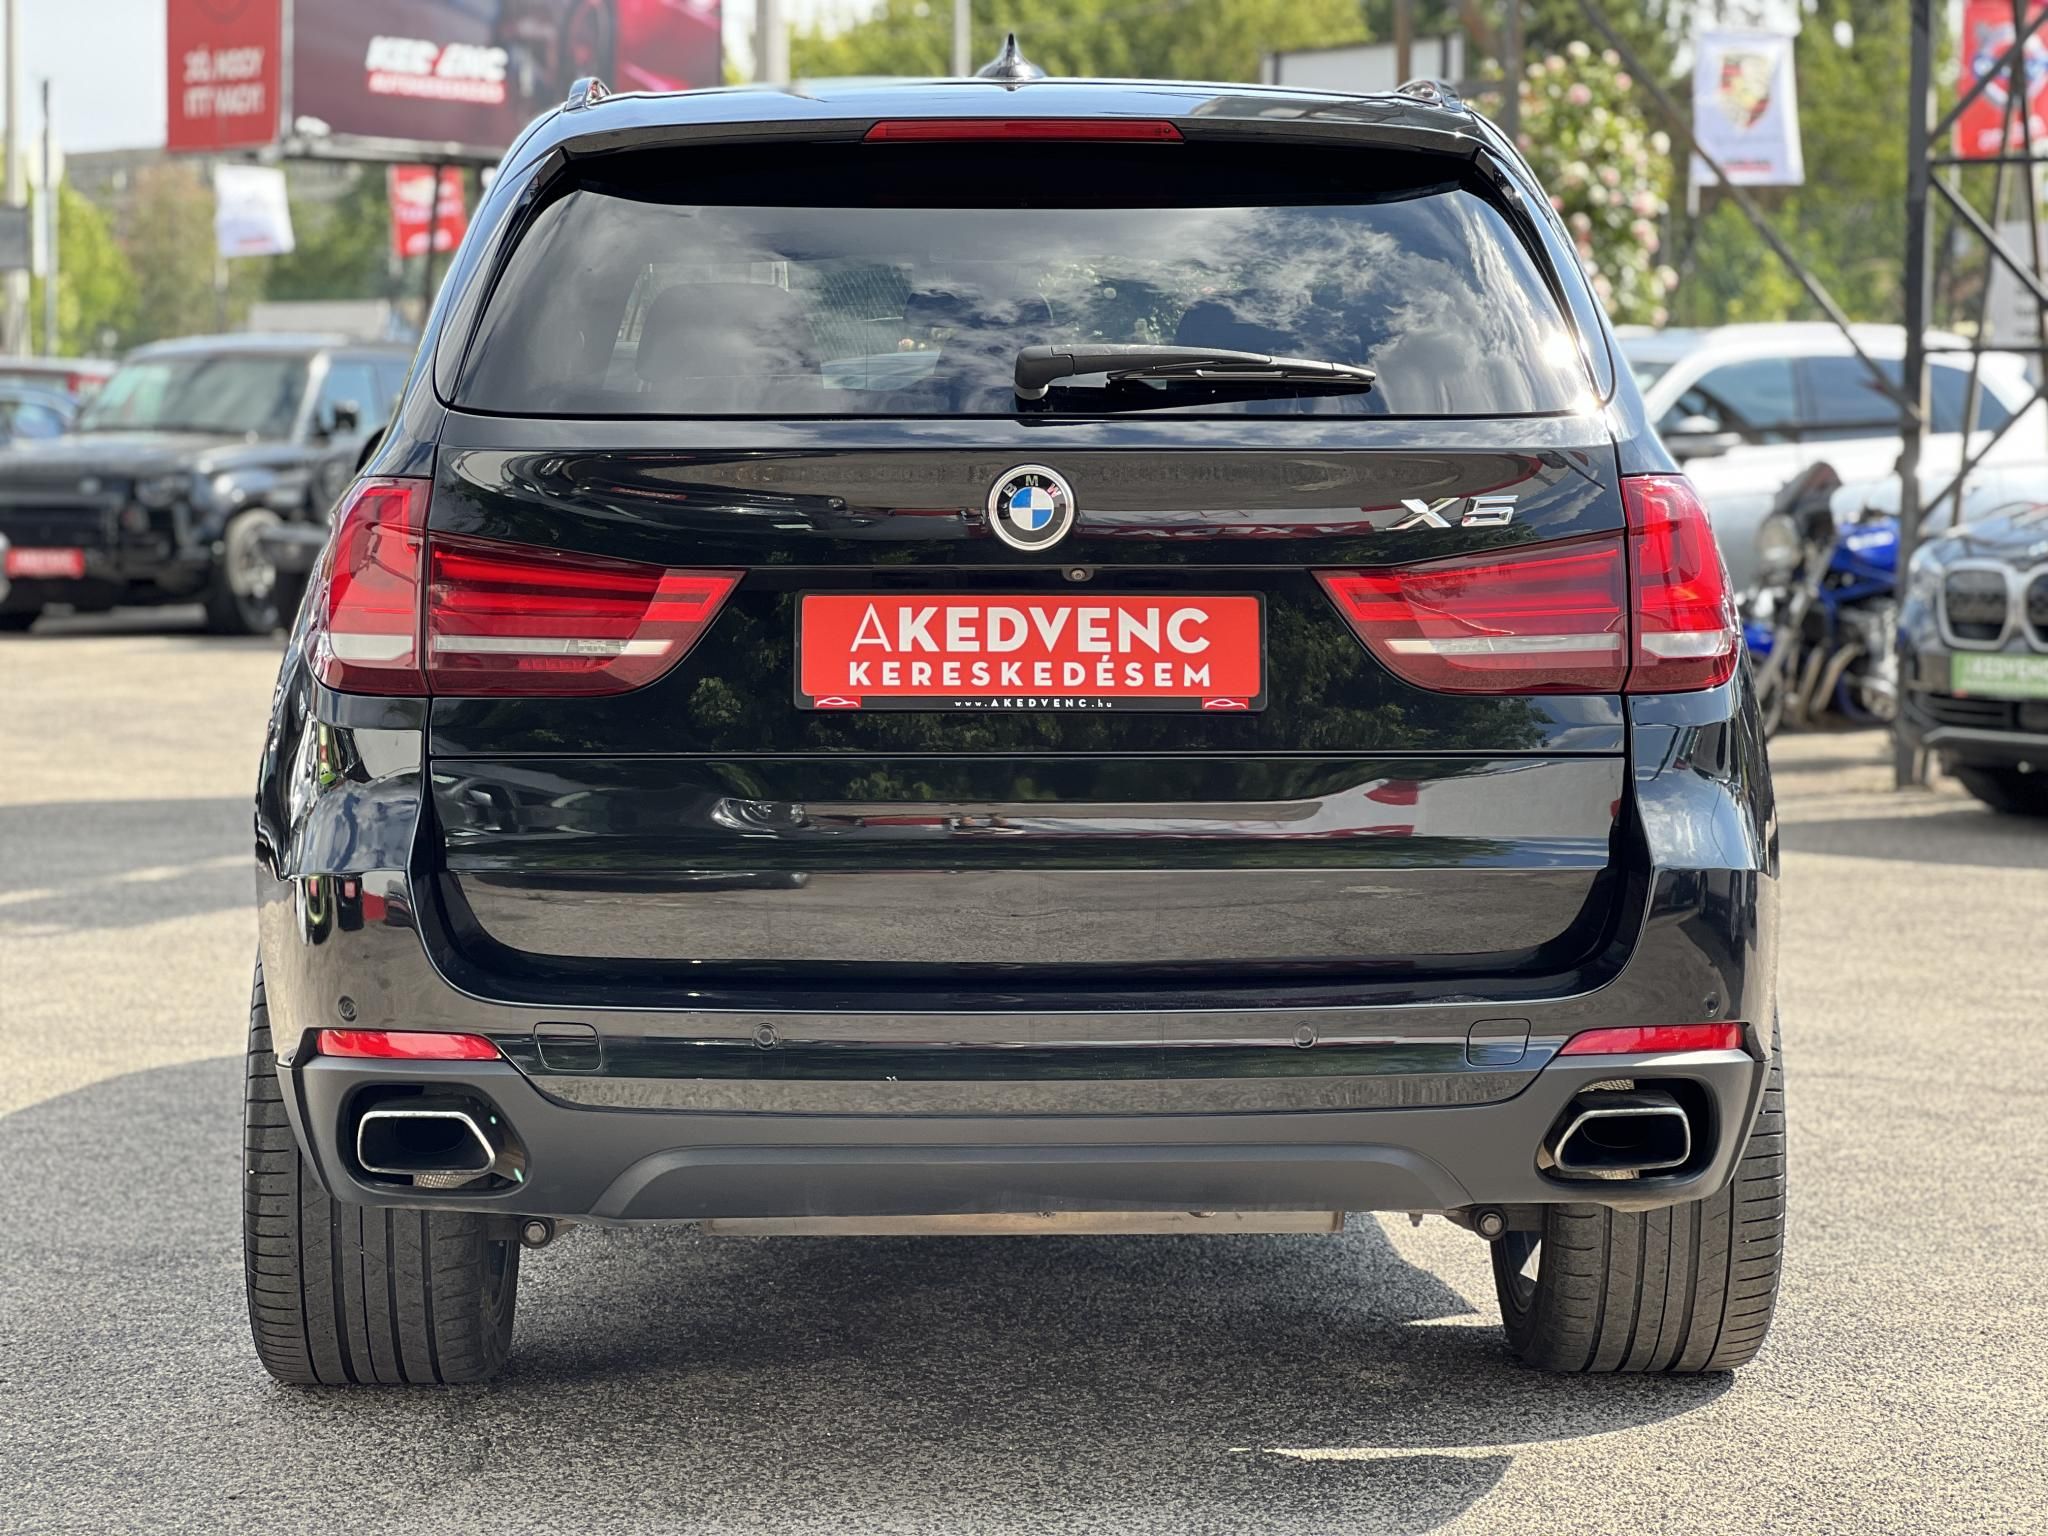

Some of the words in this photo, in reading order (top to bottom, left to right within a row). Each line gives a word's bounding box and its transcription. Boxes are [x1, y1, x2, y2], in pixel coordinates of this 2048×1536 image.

[1003, 475, 1061, 497] BMW
[1386, 495, 1519, 530] X5
[849, 603, 1211, 654] AKEDVENC
[849, 655, 1211, 688] KERESKEDÉSEM
[954, 698, 1112, 708] www.AKEDVENC.hu
